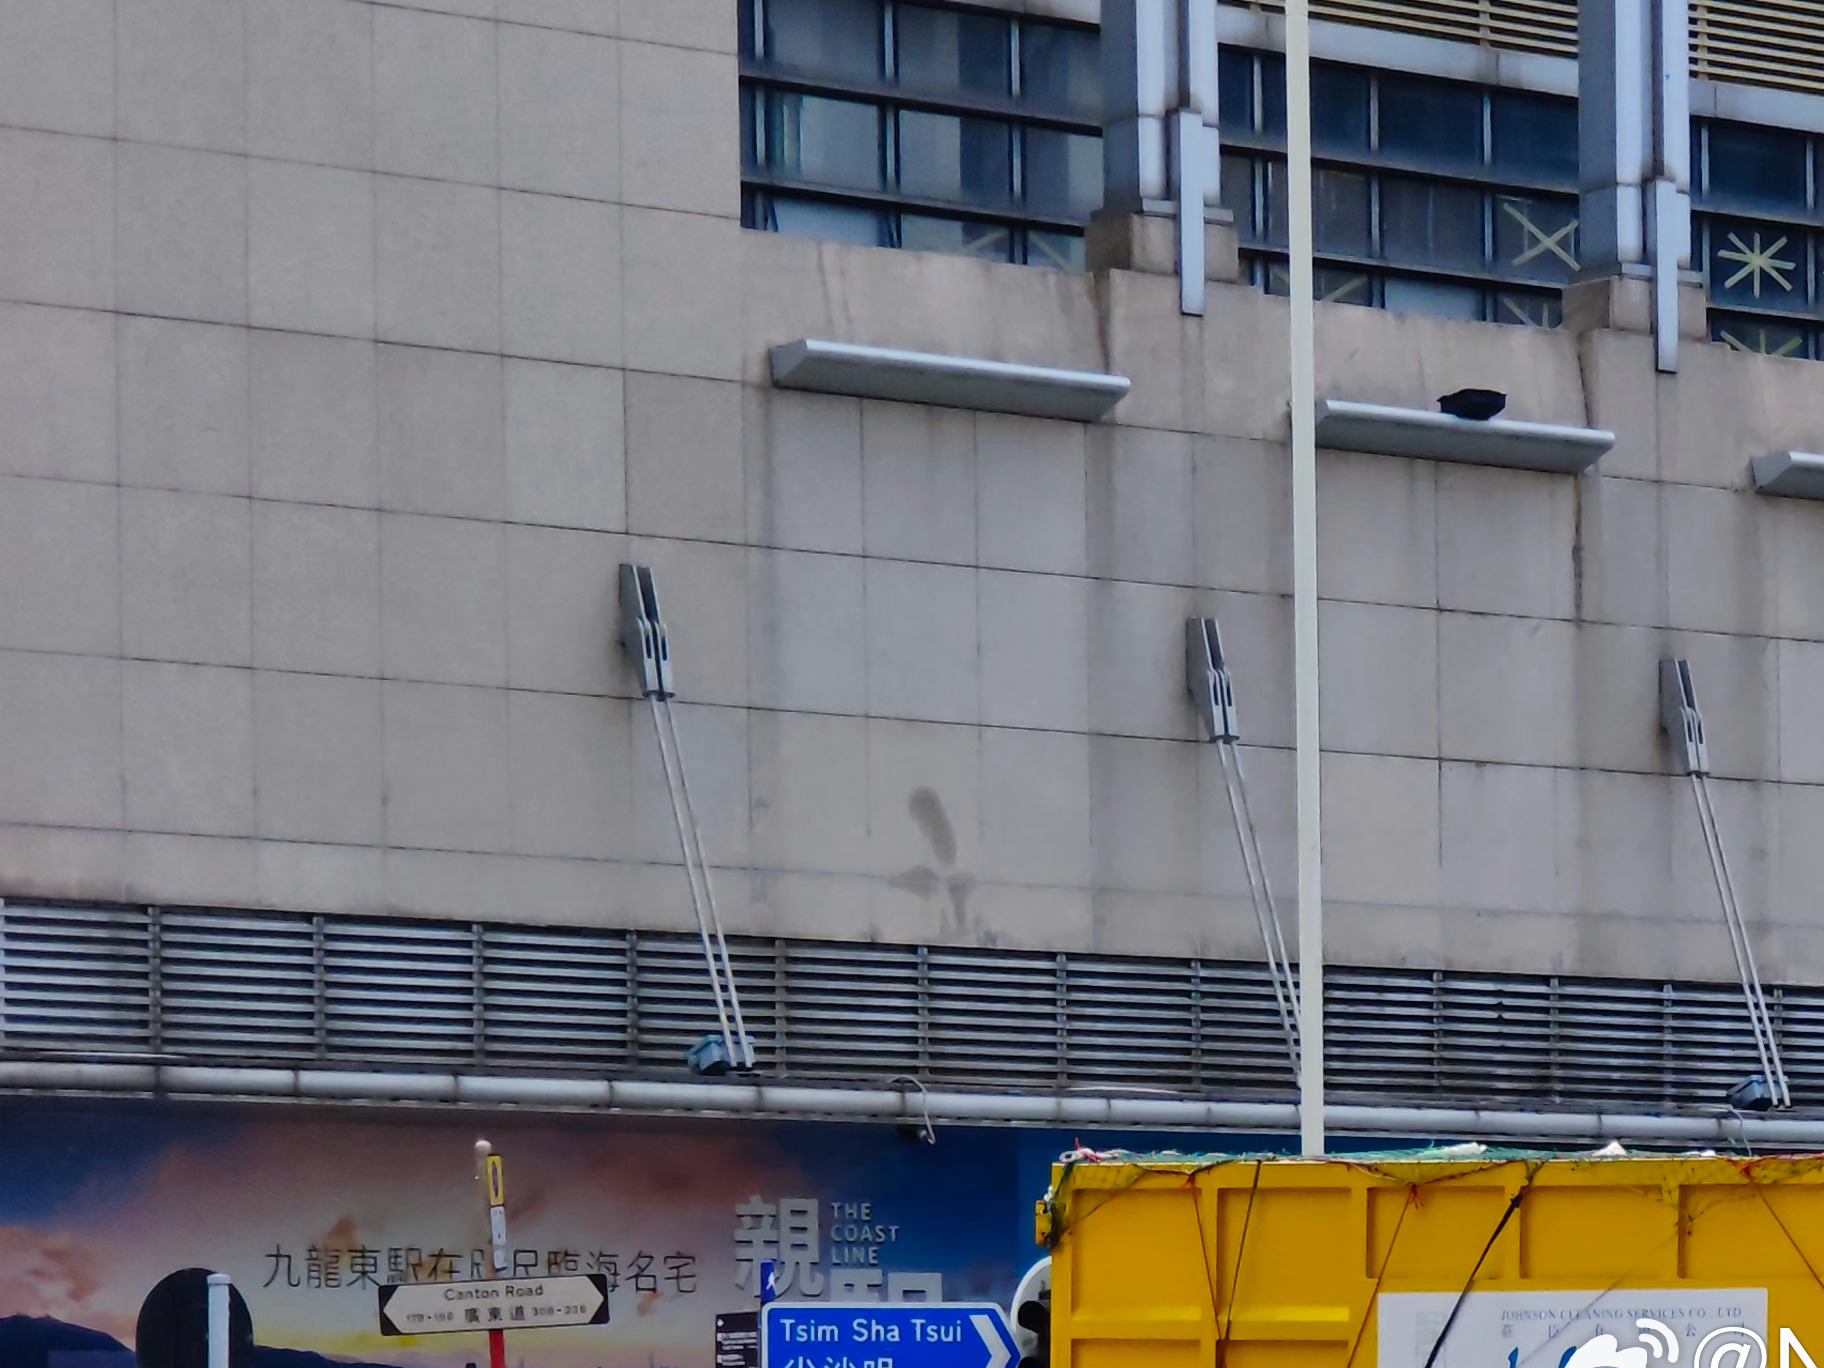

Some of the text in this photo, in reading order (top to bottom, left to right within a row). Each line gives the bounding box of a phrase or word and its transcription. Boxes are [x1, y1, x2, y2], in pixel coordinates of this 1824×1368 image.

[830, 1202, 872, 1221] THE
[830, 1225, 900, 1243] COAST
[831, 1246, 879, 1265] LINE
[444, 1284, 544, 1301] Canton Road
[780, 1318, 839, 1342] Tsim
[852, 1318, 900, 1342] Sha
[910, 1318, 962, 1342] Tsui
